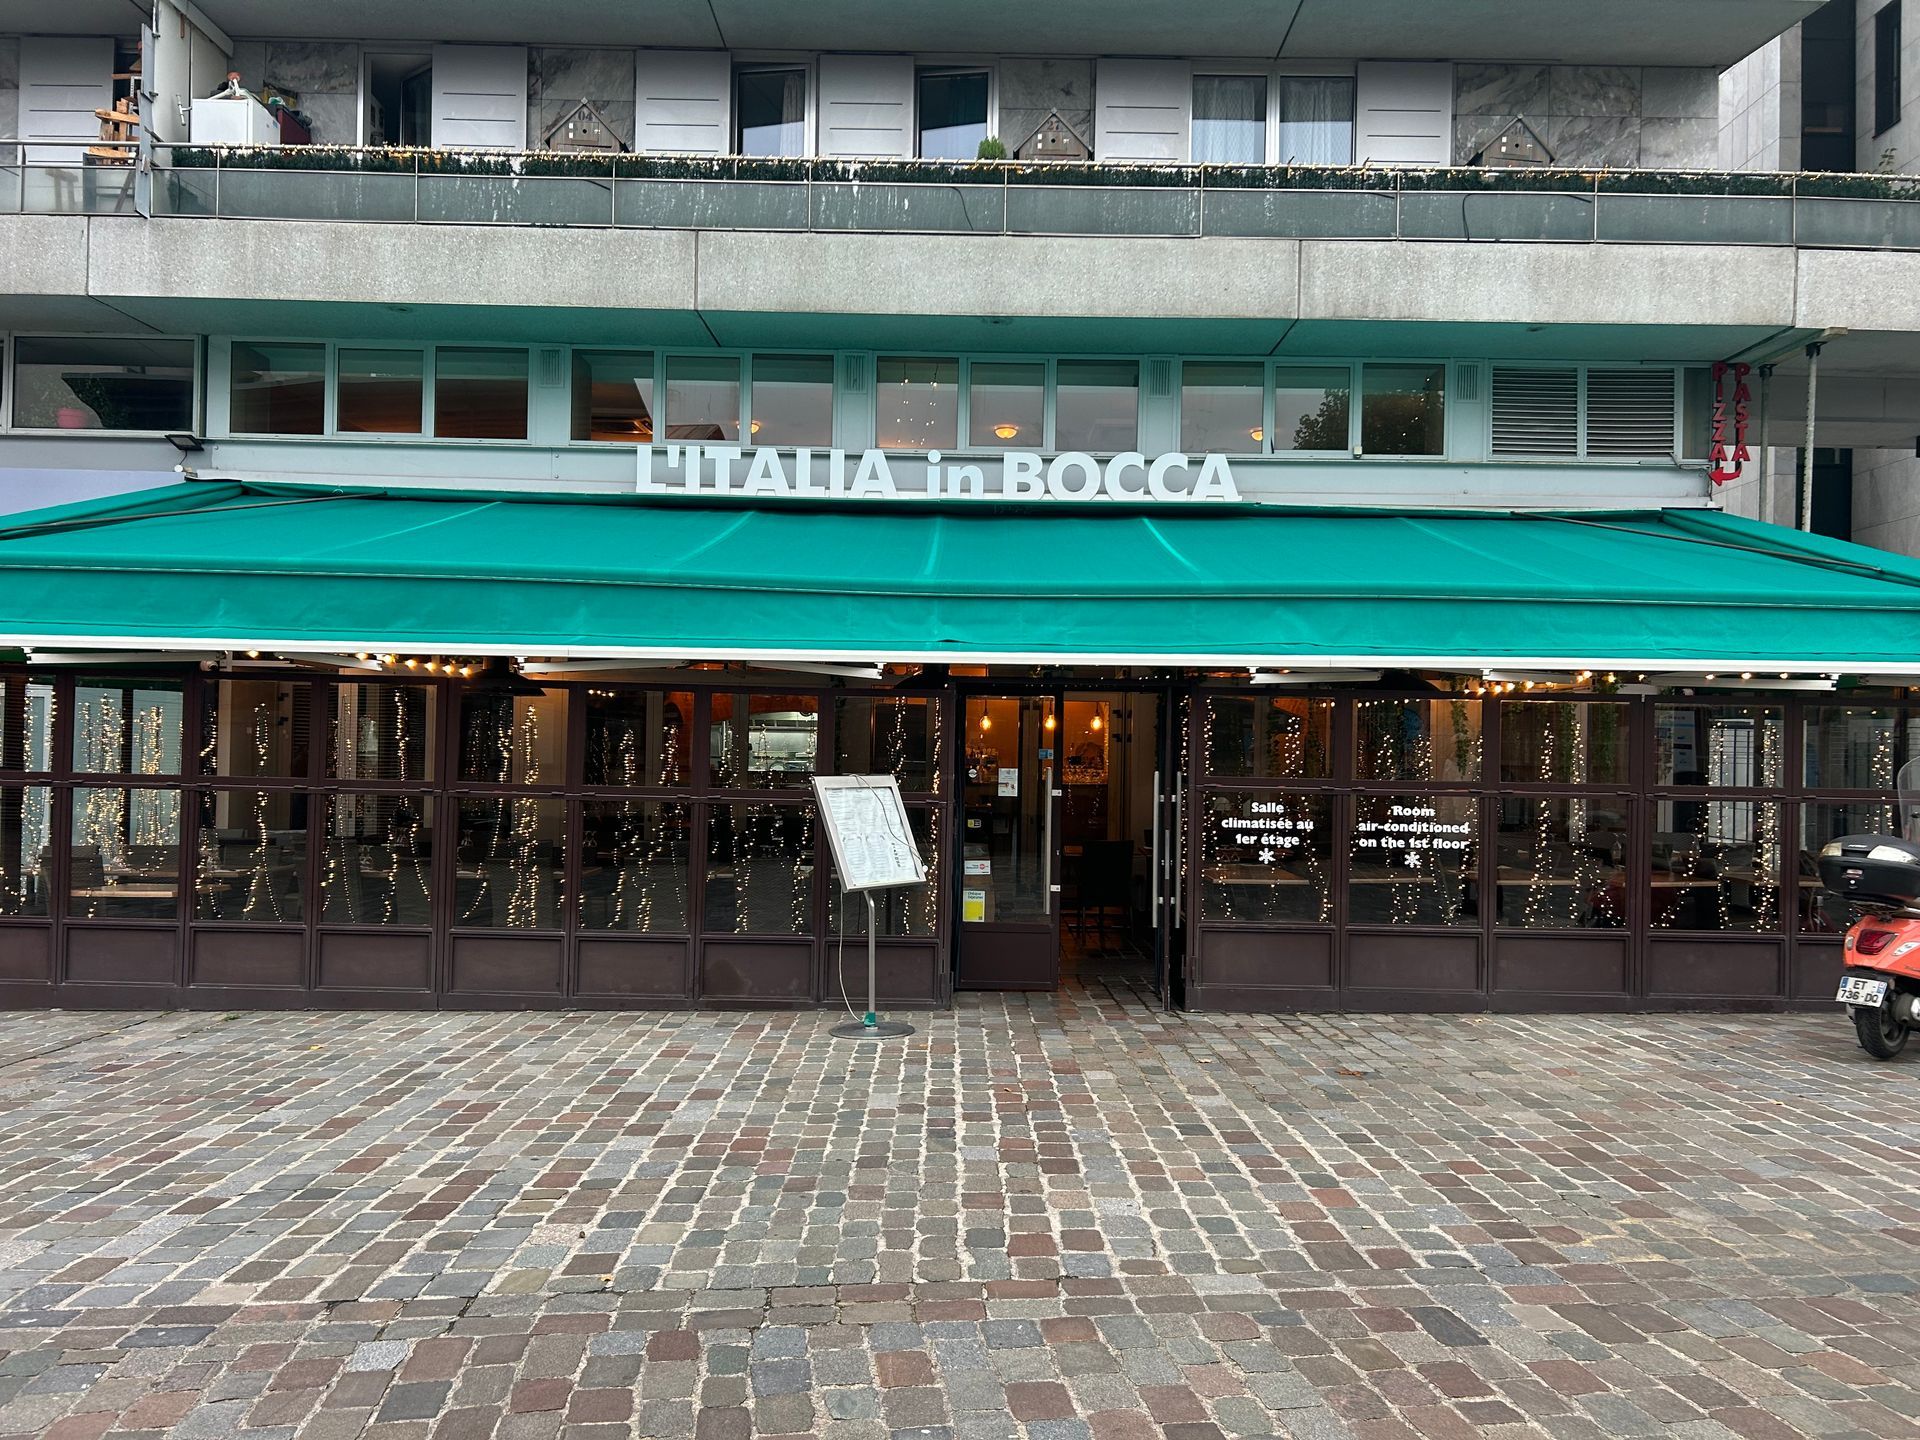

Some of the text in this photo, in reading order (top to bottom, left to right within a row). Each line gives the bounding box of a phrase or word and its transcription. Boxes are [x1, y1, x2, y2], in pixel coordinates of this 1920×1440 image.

[578, 111, 593, 121] 04
[1047, 121, 1060, 131] 27
[1709, 362, 1728, 462] PIZZA
[1731, 362, 1751, 462] PASTA
[636, 445, 1243, 502] L'ITALIA in BOCCA
[1251, 802, 1285, 813] Salle
[1391, 805, 1435, 817] Room
[1221, 817, 1314, 830] climatisée au
[1358, 821, 1470, 834] air-conditioned
[1235, 833, 1300, 848] 1er étage
[1359, 837, 1469, 849] on the 1st floor
